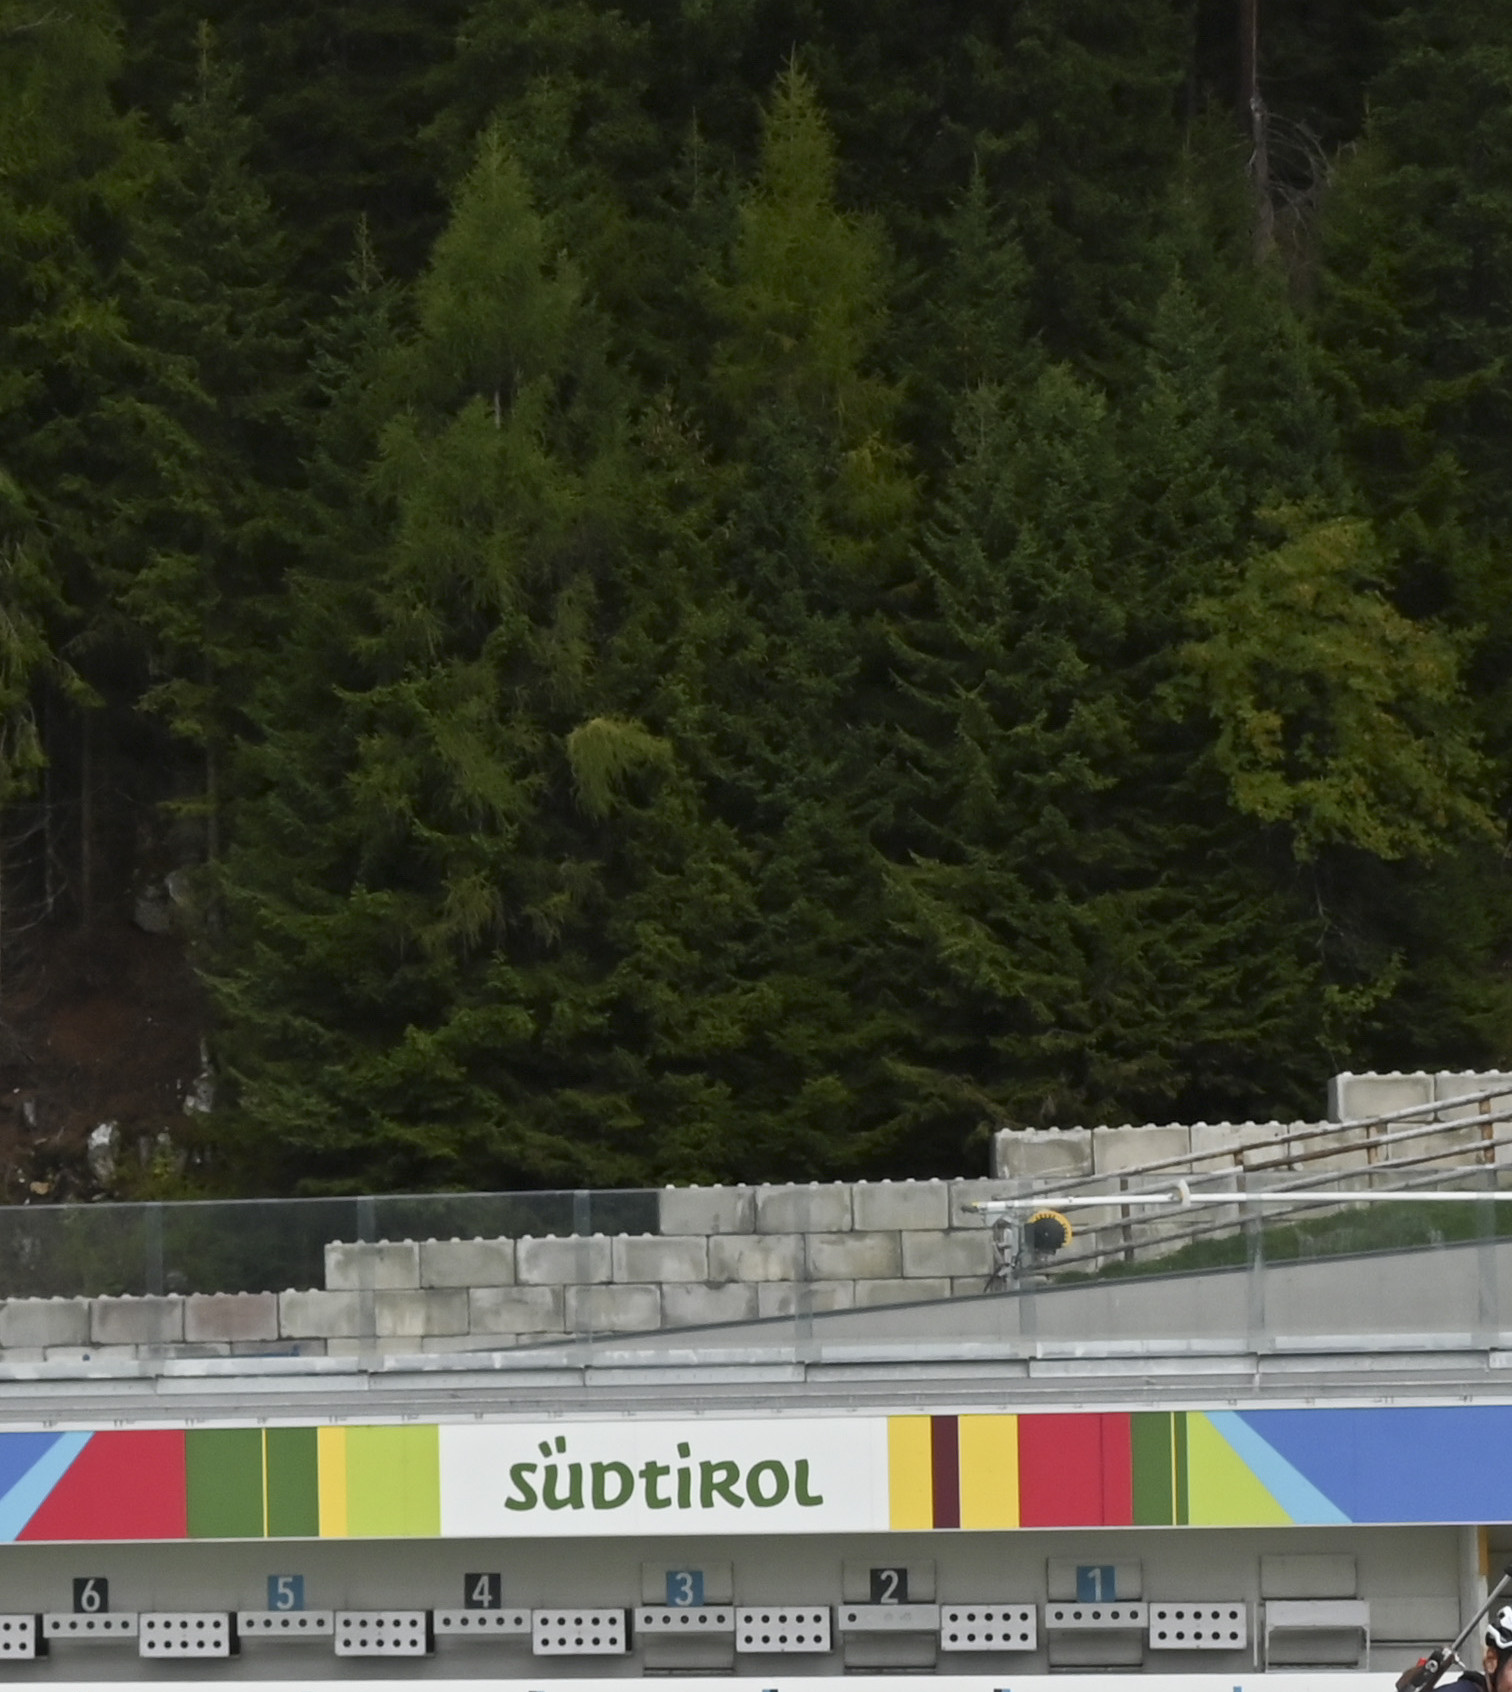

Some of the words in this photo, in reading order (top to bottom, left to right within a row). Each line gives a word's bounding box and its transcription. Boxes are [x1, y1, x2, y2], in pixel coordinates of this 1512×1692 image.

[80, 1578, 101, 1613] 6
[276, 1576, 294, 1611] 5
[472, 1574, 493, 1608] 4
[674, 1571, 694, 1606] 3
[879, 1569, 900, 1605] 2
[1087, 1567, 1102, 1603] 1
